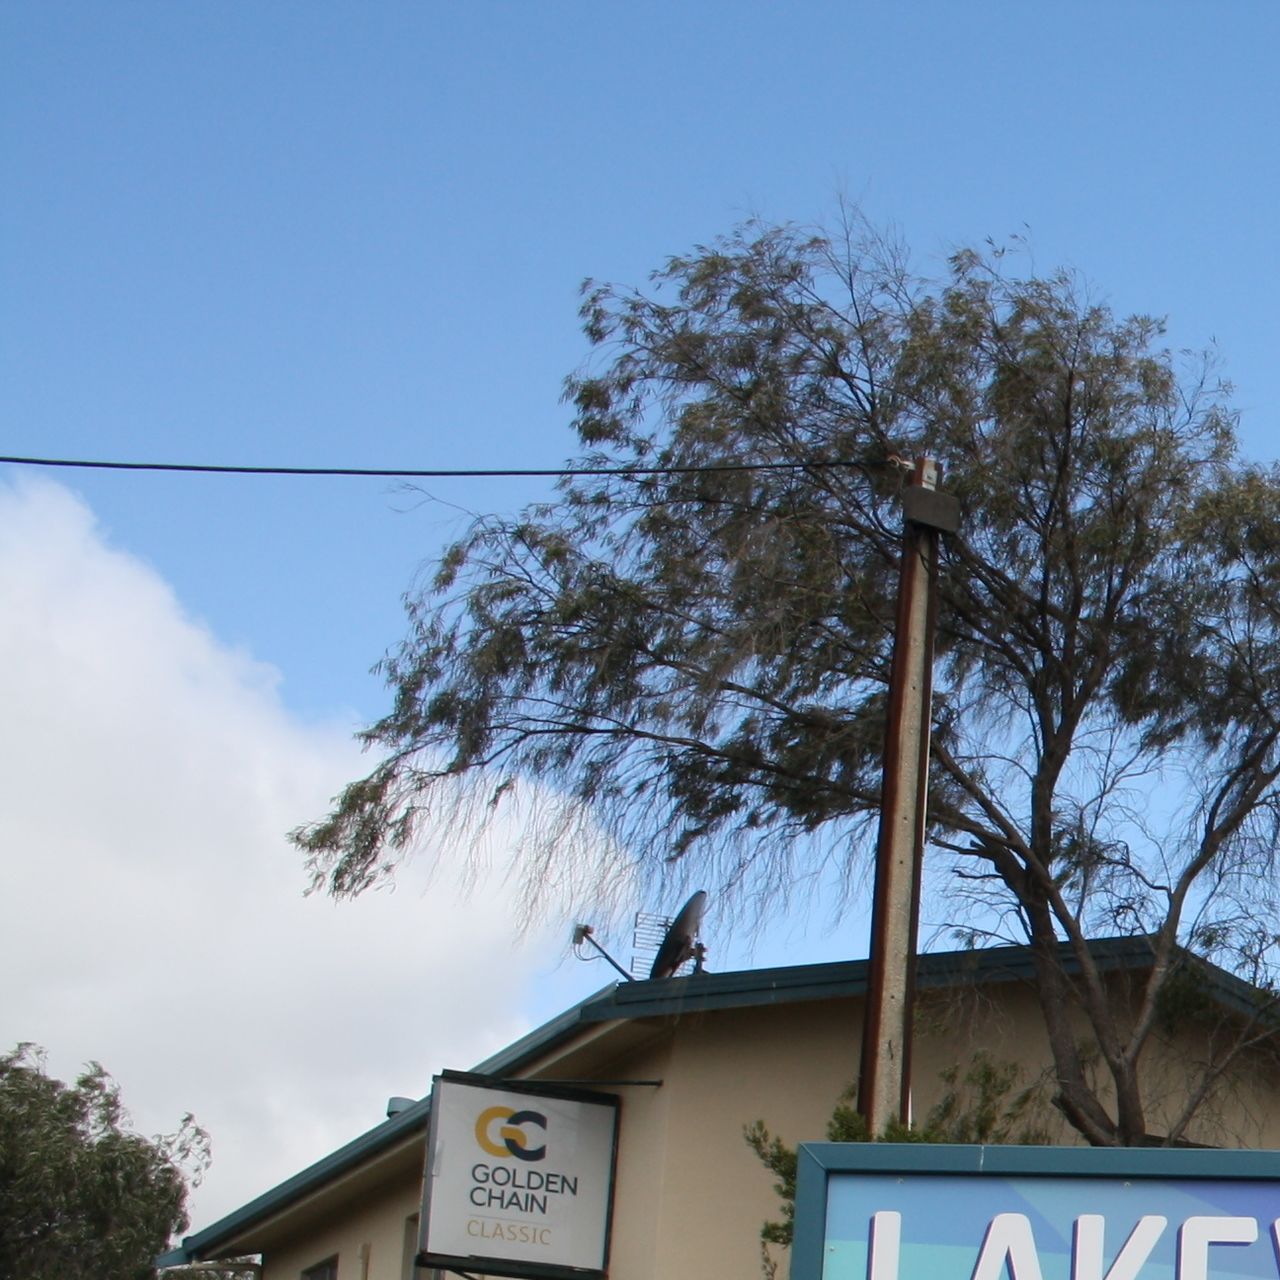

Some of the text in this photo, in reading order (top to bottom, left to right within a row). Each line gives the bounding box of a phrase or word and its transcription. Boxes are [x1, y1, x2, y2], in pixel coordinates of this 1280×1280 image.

[472, 1164, 578, 1196] GOLDEN
[470, 1186, 547, 1214] CHAIN
[467, 1220, 551, 1245] CLASSIC
